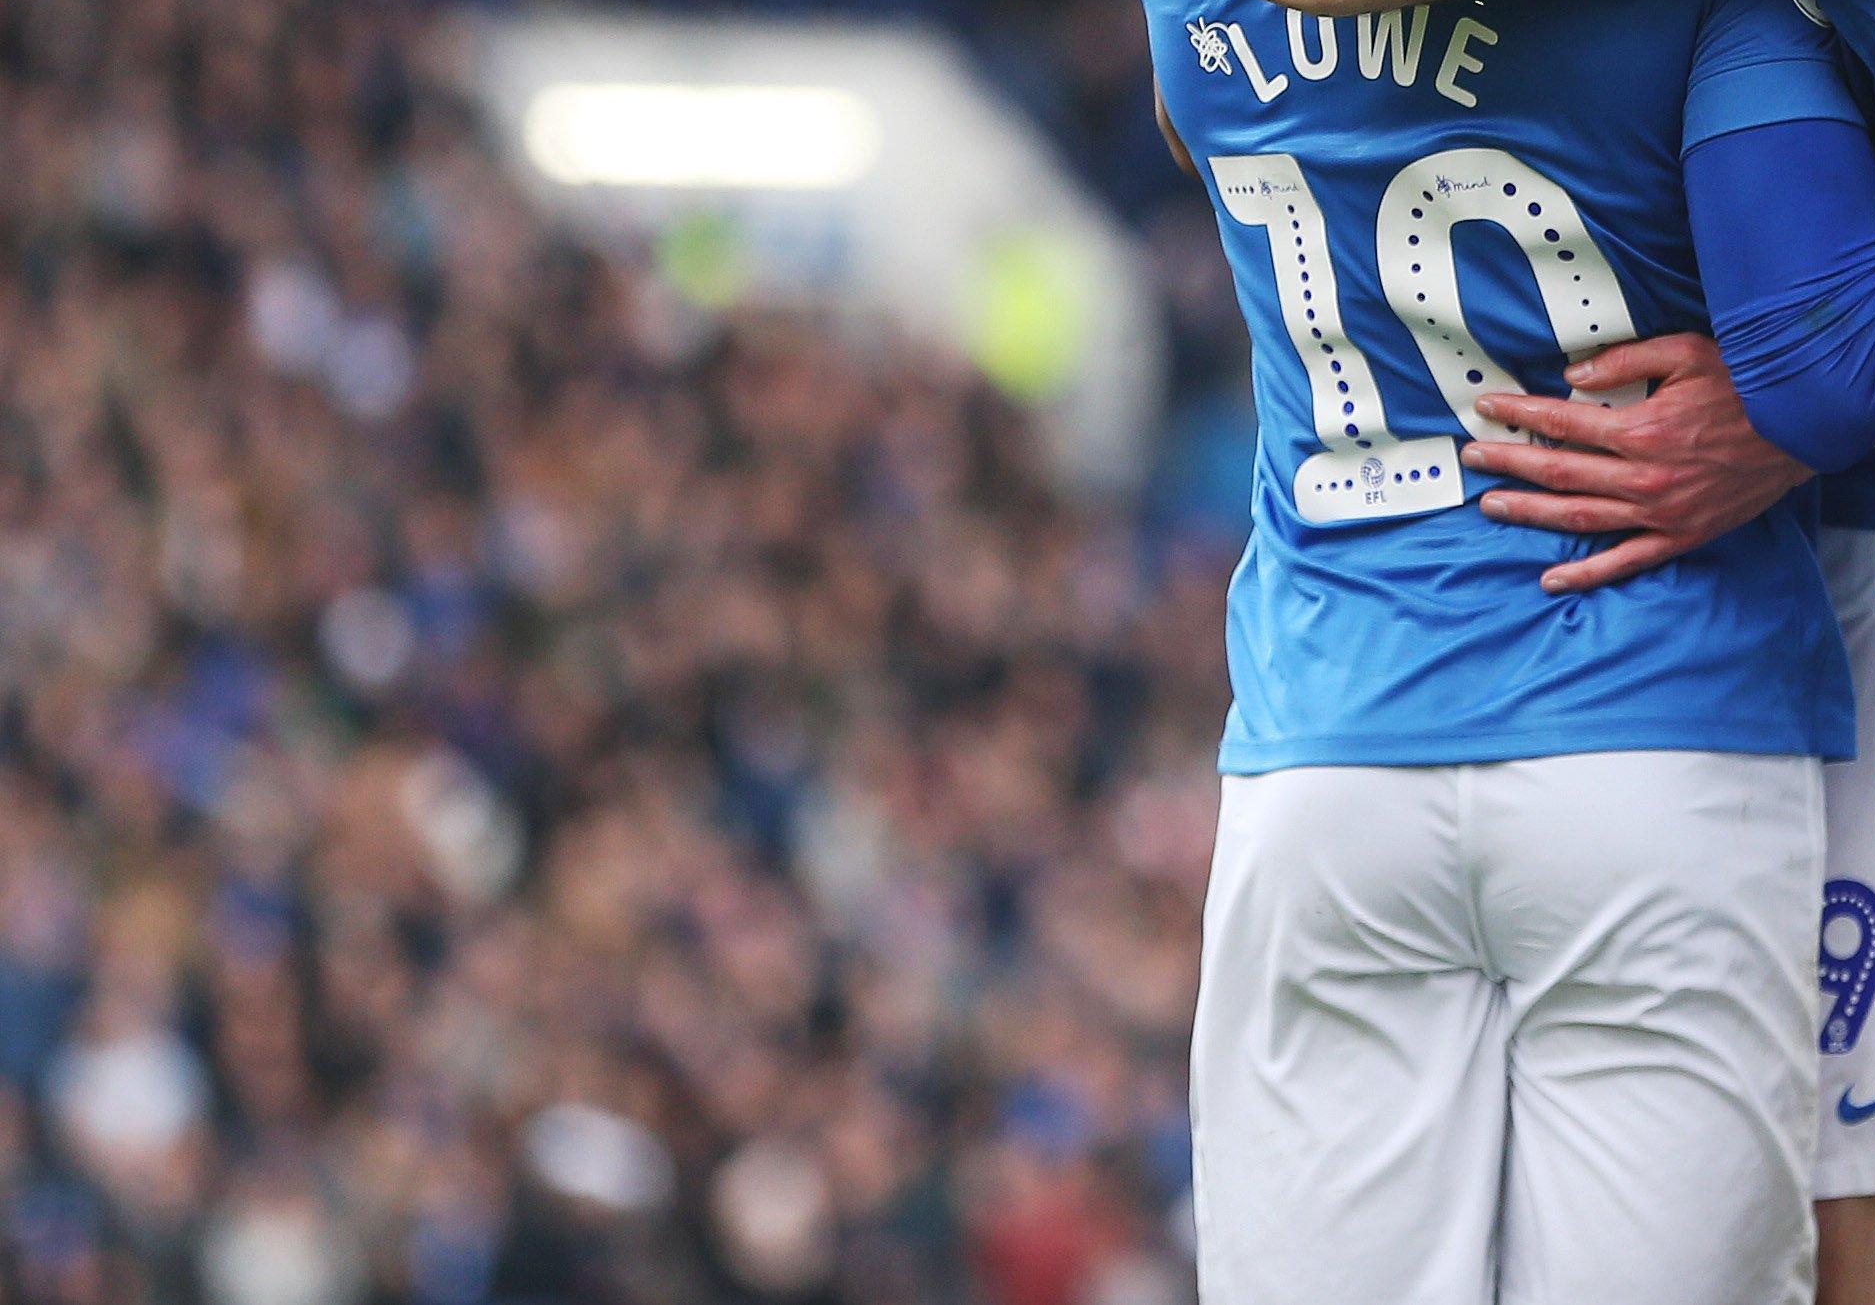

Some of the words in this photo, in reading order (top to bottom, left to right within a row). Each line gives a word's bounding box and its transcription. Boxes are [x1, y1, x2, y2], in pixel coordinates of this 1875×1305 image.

[1227, 4, 1499, 108] LOWE
[1453, 176, 1492, 193] mind
[1207, 147, 1648, 524] 10
[1365, 490, 1388, 505] EFL
